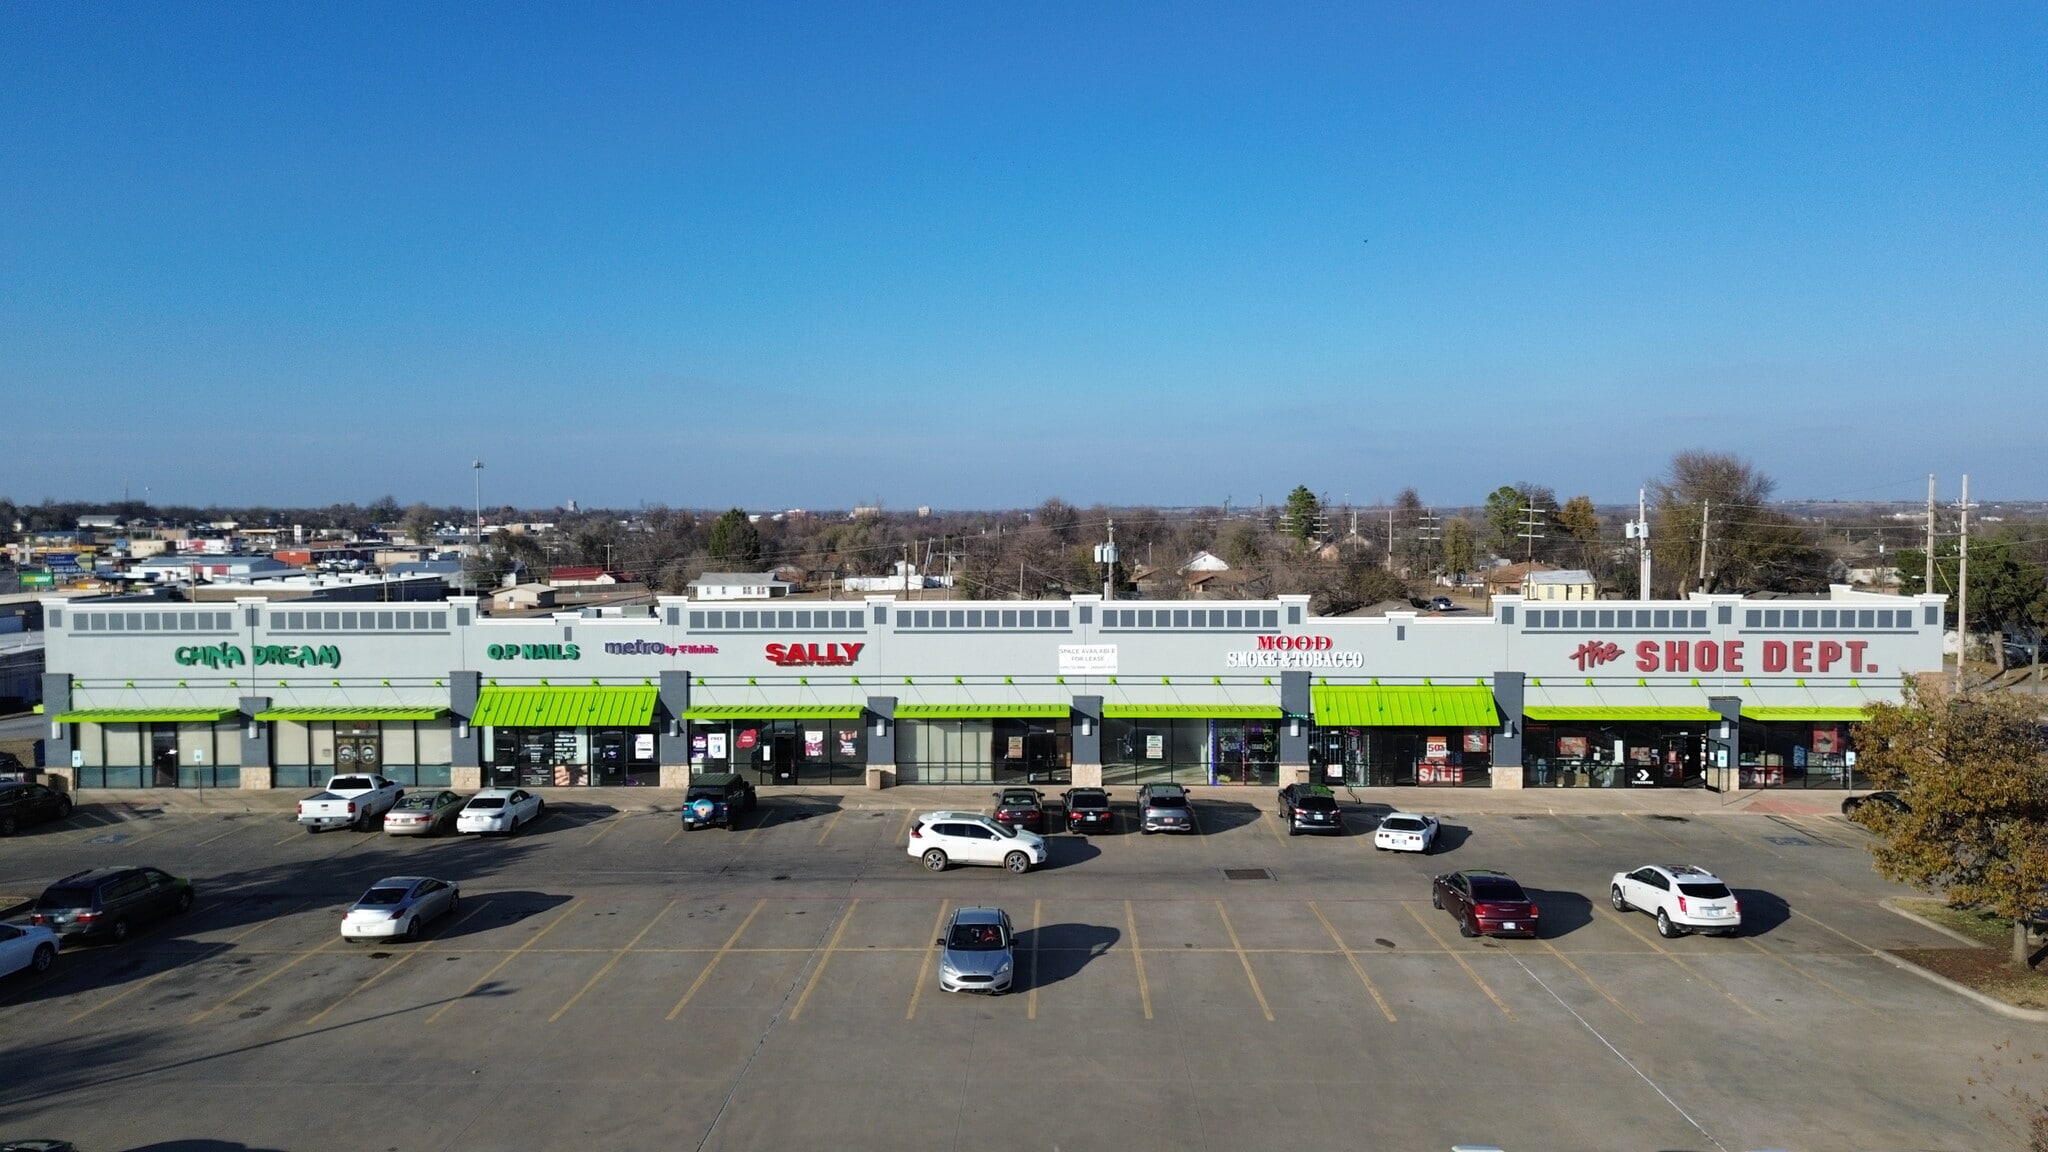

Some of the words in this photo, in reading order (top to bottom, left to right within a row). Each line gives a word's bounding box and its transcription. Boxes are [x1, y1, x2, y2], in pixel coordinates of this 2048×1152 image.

[605, 639, 665, 655] metro
[1257, 635, 1333, 651] MOOD
[175, 642, 245, 669] CHINA
[252, 645, 341, 668] DREAM
[521, 644, 580, 660] NAILS
[765, 643, 865, 662] SALLY
[1227, 651, 1279, 668] SMOKE
[1280, 651, 1294, 668] &
[1293, 651, 1364, 668] TOBACCO
[1569, 640, 1625, 672] the
[1635, 640, 1744, 672] SHOE
[1763, 640, 1879, 672] DEPT.
[1418, 766, 1461, 783] SALE
